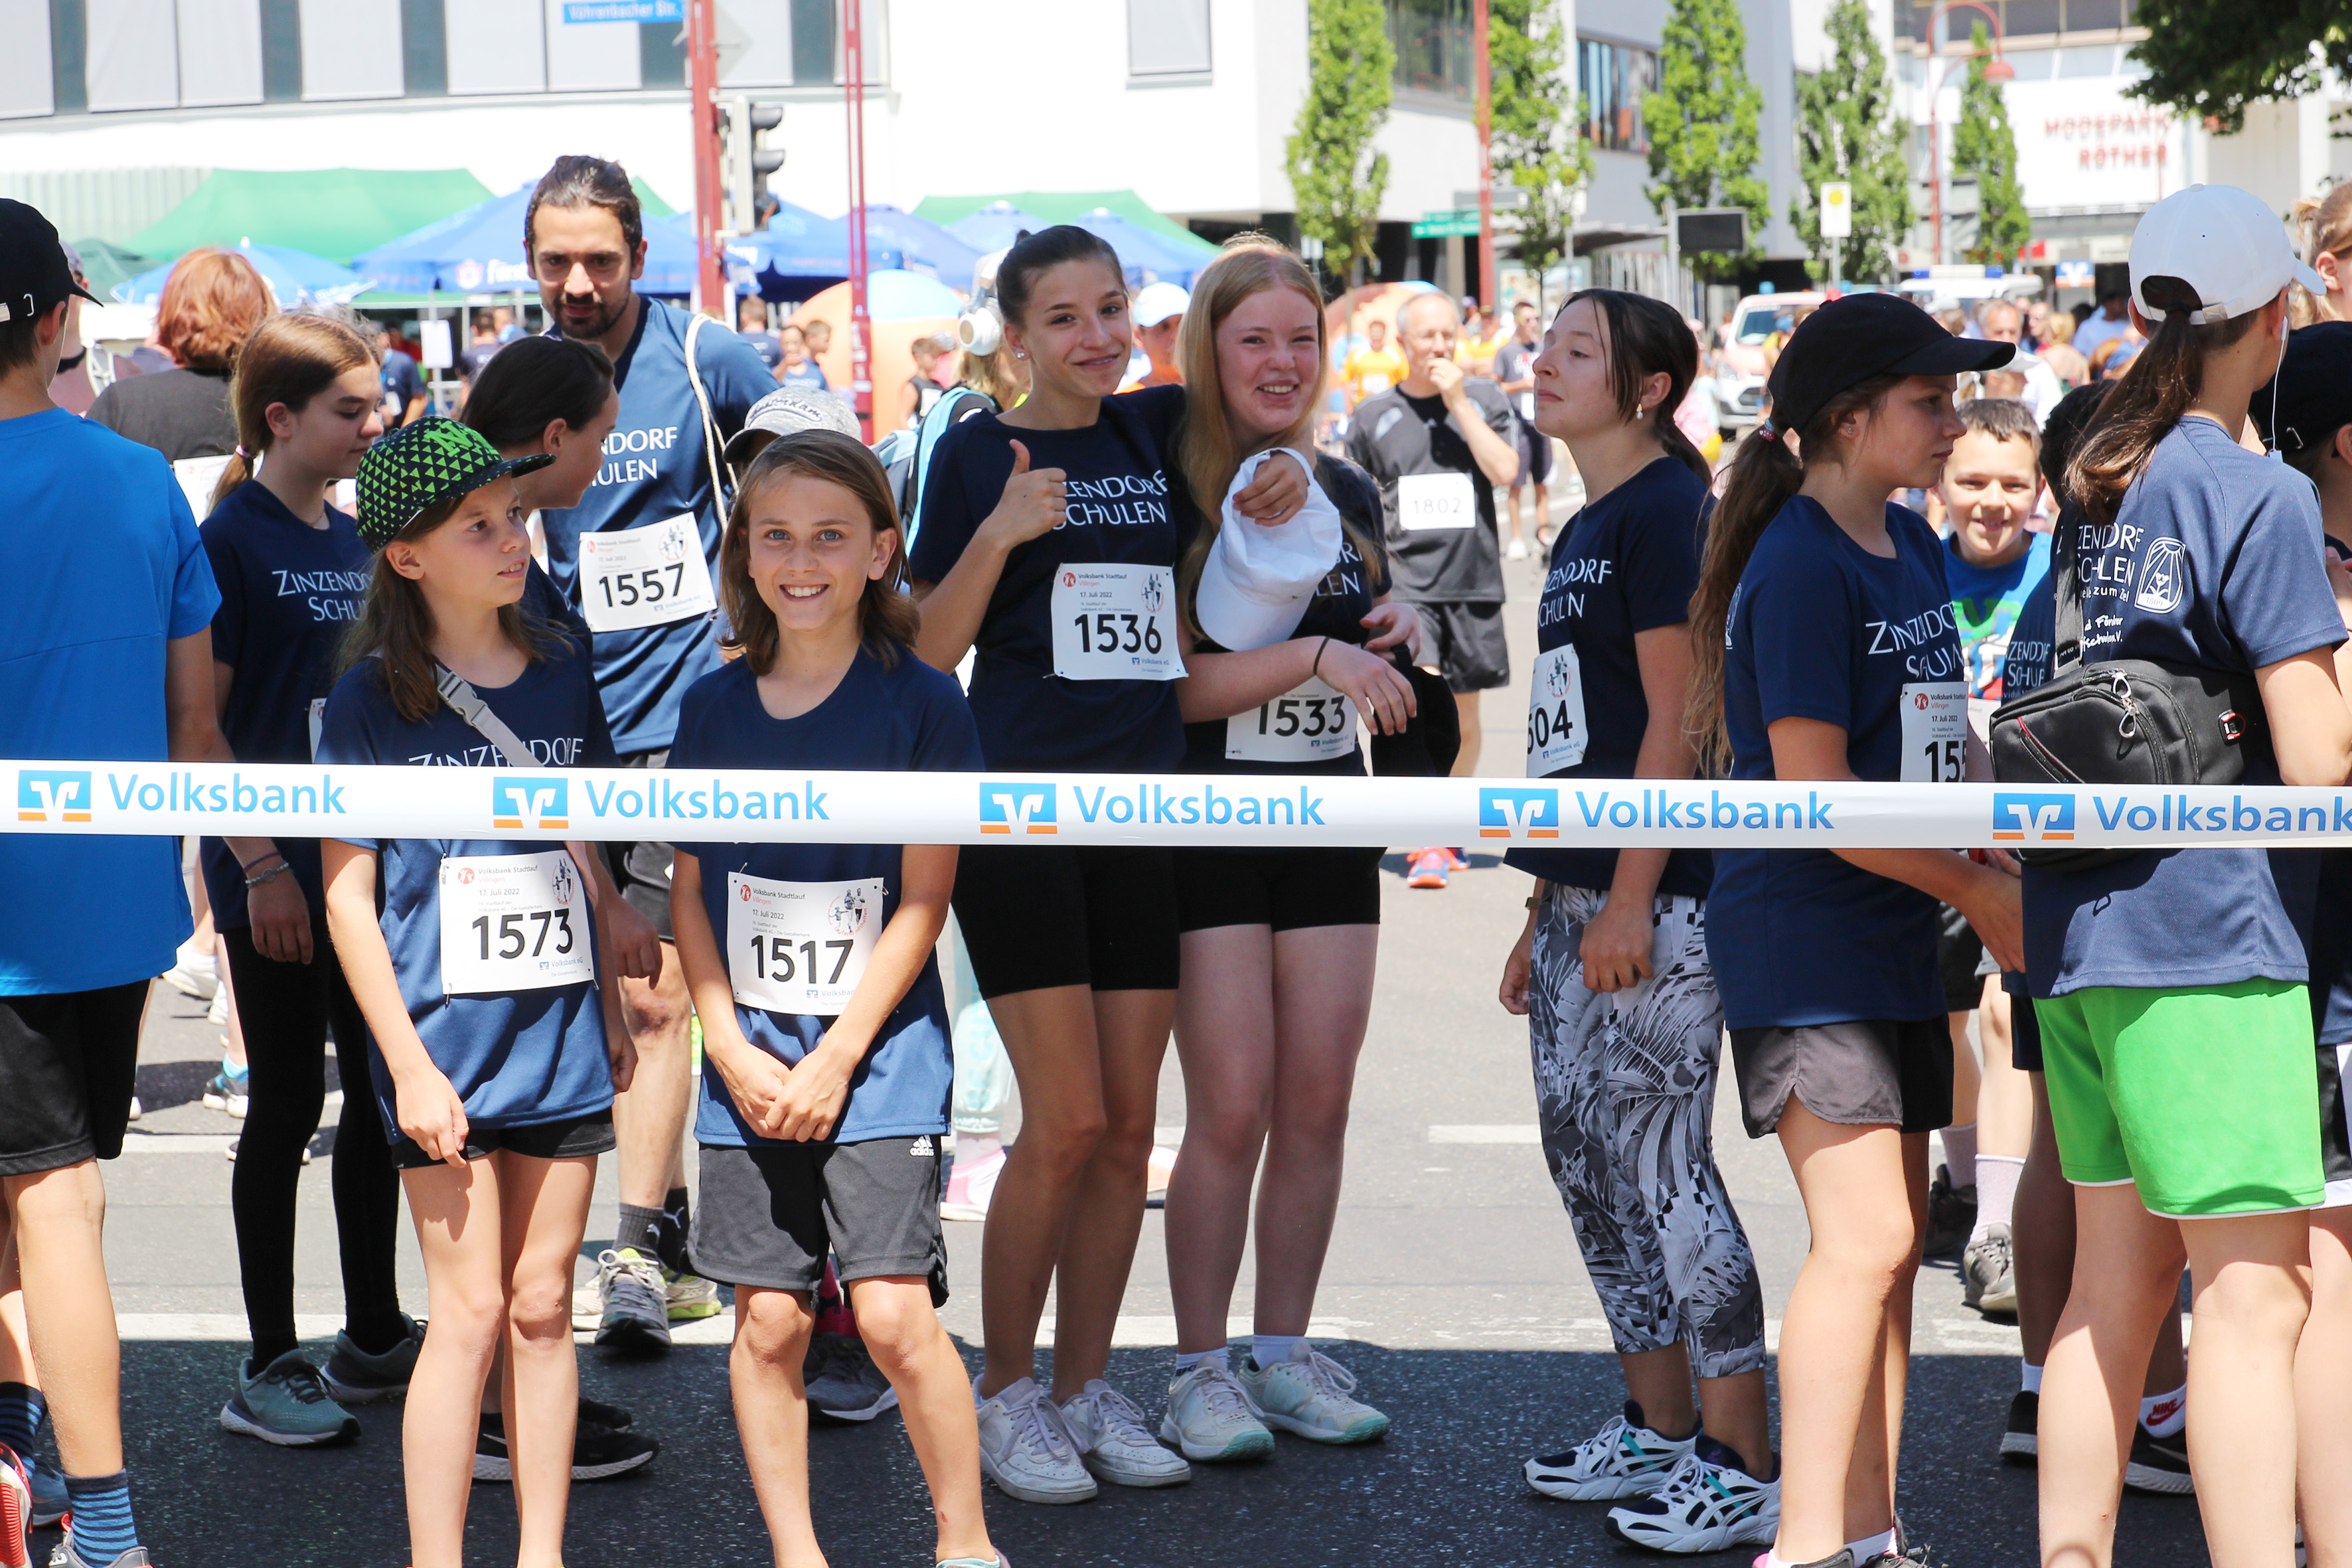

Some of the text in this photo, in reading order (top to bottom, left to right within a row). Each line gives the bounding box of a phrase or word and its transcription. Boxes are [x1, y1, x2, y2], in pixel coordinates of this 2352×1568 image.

[2045, 112, 2168, 138] MODEPARK
[2079, 143, 2166, 169] RÖTHER
[591, 457, 657, 487] ULEN
[1053, 501, 1166, 530] CHULEN
[1413, 497, 1461, 514] 1802
[599, 562, 684, 607] 1557
[2093, 586, 2118, 597] zum
[308, 596, 366, 621] SCHU
[2146, 596, 2163, 607] 1809
[1075, 614, 1162, 654] 1536
[1259, 696, 1346, 737] 1533
[108, 773, 347, 815] Volksbank
[584, 779, 830, 821] Volksbank
[1073, 783, 1326, 826] Volksbank
[1575, 789, 1835, 830] Volksbank
[753, 888, 777, 898] Volksbank
[753, 896, 771, 905] Villingen
[473, 908, 573, 960] 1573
[551, 957, 576, 967] Volksbank
[751, 935, 854, 984] 1517
[2152, 1398, 2177, 1415] NIKE
